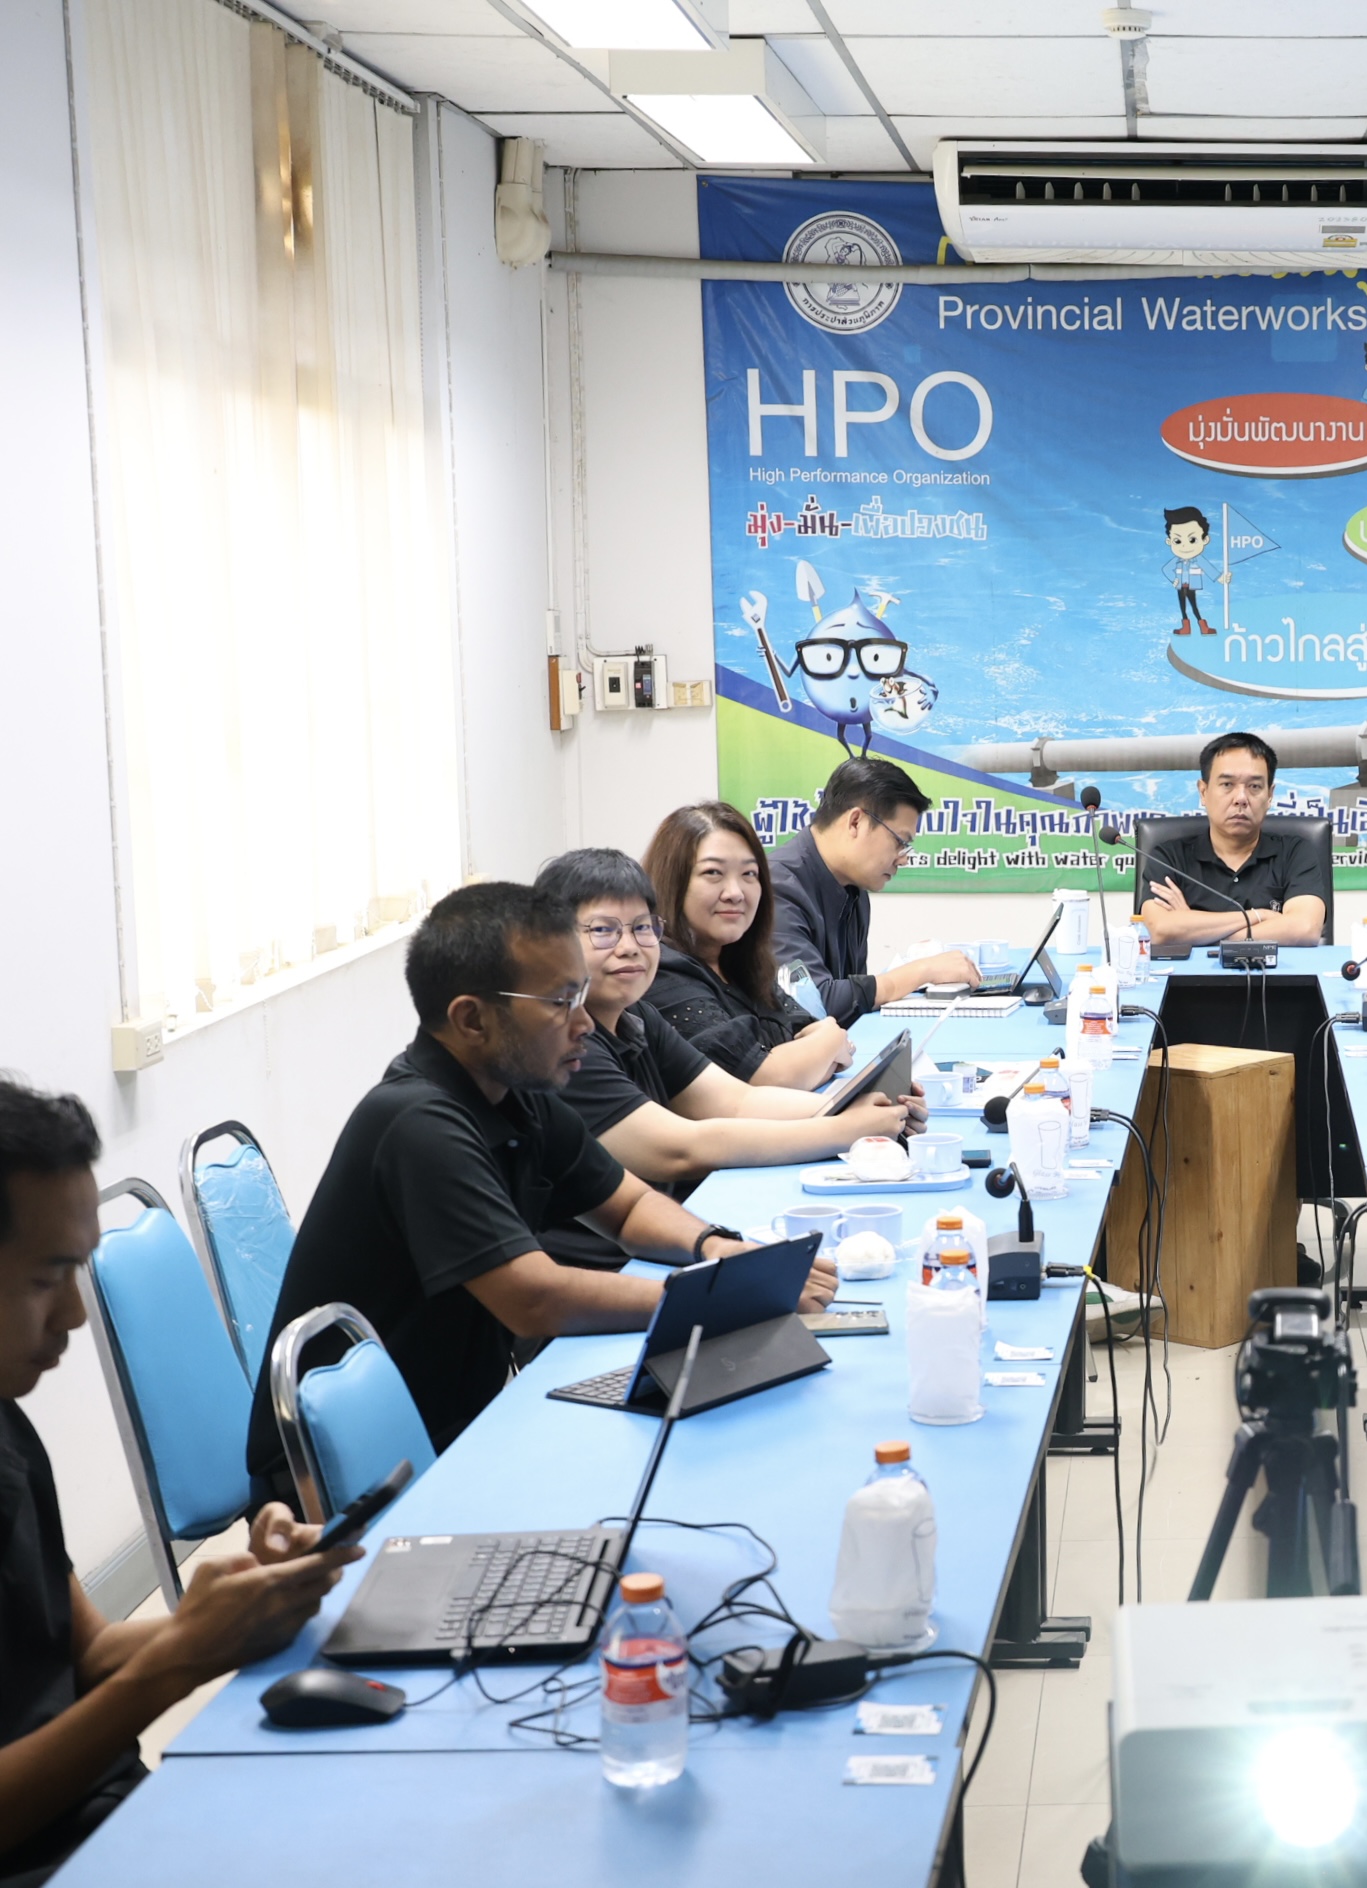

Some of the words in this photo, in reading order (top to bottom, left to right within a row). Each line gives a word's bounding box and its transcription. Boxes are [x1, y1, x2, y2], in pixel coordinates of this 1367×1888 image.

[939, 296, 1122, 331] Provincial
[1143, 296, 1367, 332] Waterworks
[747, 368, 993, 461] HPO
[1188, 408, 1365, 449] มุ่งมั่นพัฒนางาน
[749, 467, 786, 486] High
[790, 467, 889, 486] Performance
[893, 469, 990, 488] Organization
[1230, 535, 1263, 549] HPO
[937, 851, 997, 872] delight
[1006, 852, 1046, 866] with
[1055, 851, 1104, 866] water
